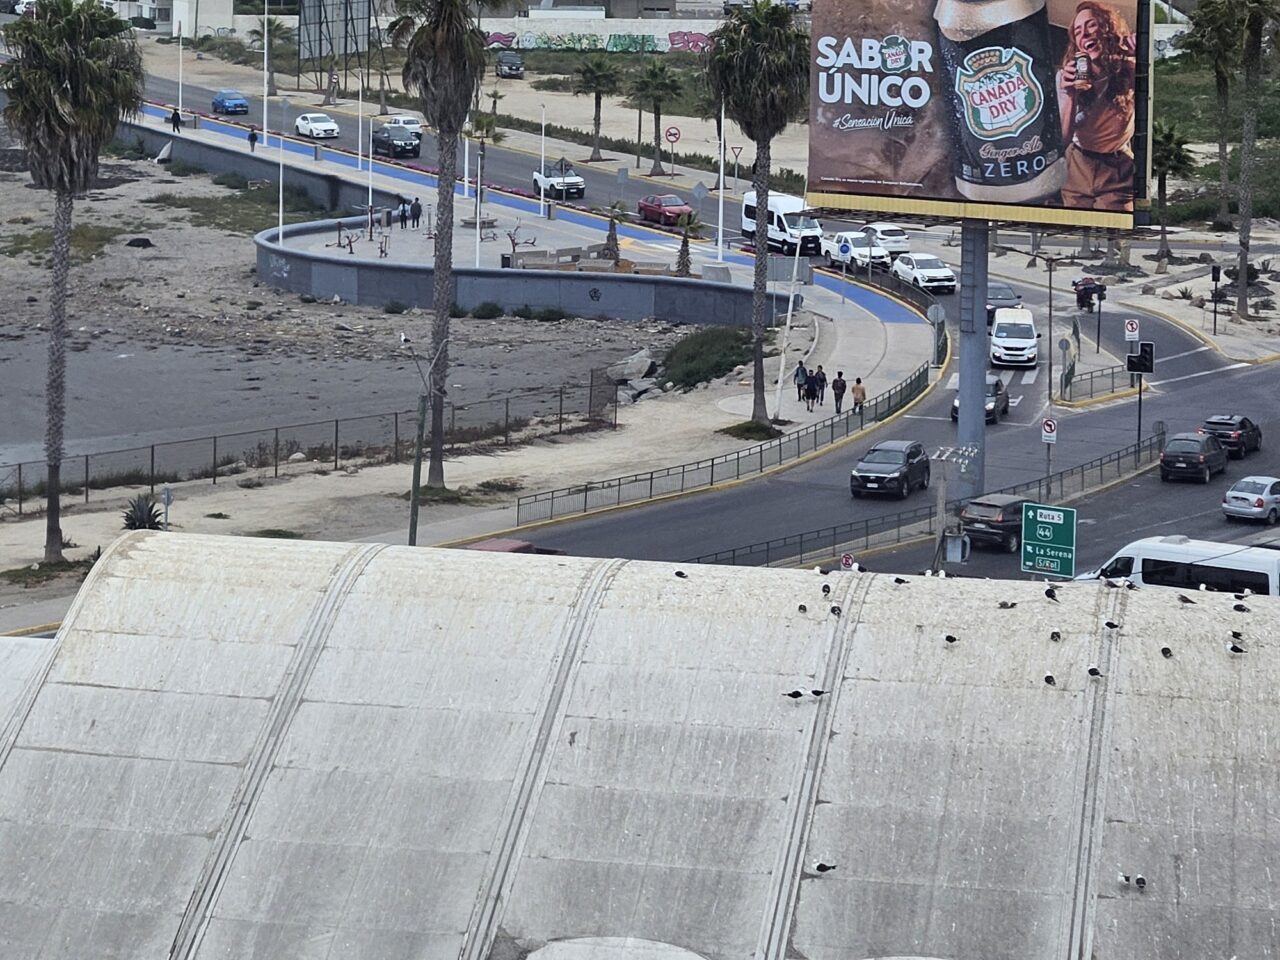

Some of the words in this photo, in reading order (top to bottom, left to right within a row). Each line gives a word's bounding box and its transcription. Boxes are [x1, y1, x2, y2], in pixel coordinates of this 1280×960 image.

[816, 35, 933, 73] SABR
[817, 67, 931, 108] ÚNICO
[969, 74, 1027, 106] CANADA
[988, 96, 1018, 119] DRY
[979, 142, 1019, 163] Ginger
[983, 155, 1046, 178] ZERO
[1039, 511, 1055, 521] Ruta
[1056, 513, 1062, 522] 5
[1038, 527, 1051, 538] 44
[1036, 546, 1045, 555] La
[1046, 548, 1072, 559] Serena
